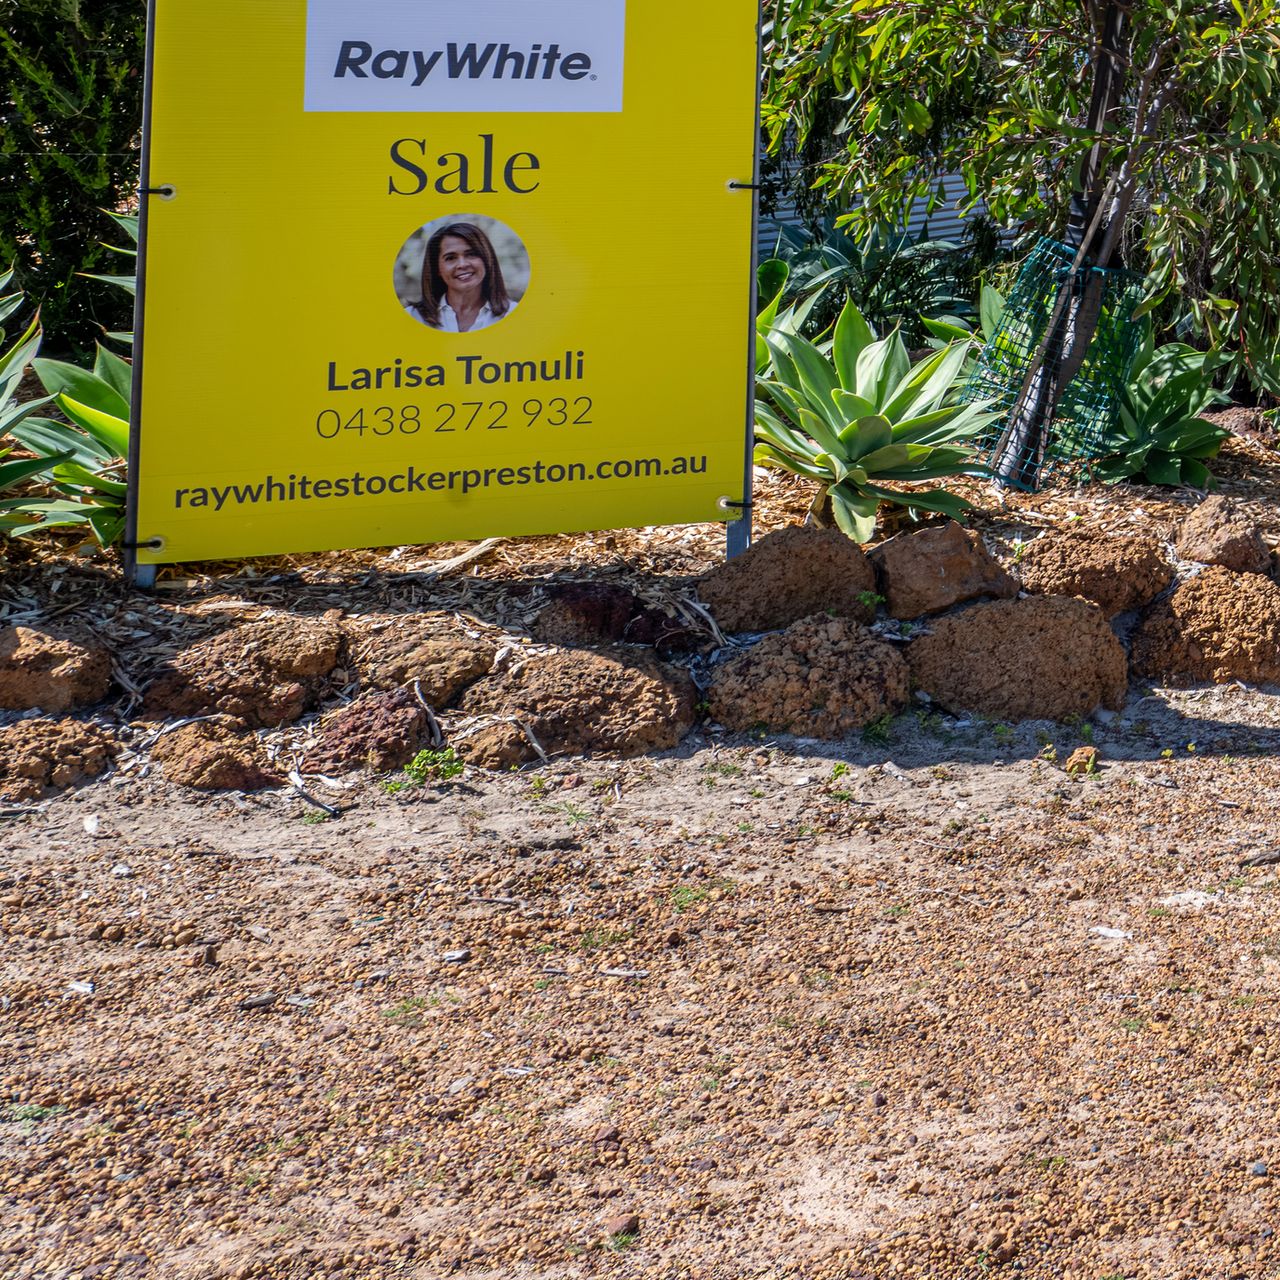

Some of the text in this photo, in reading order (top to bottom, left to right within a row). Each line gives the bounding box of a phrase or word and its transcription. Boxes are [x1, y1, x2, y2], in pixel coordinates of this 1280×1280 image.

[387, 133, 541, 196] Sale
[327, 350, 585, 392] Larisa Tomuli
[315, 396, 593, 439] 0438 272 932
[174, 455, 708, 512] raywhitestockerpreston.com.au
